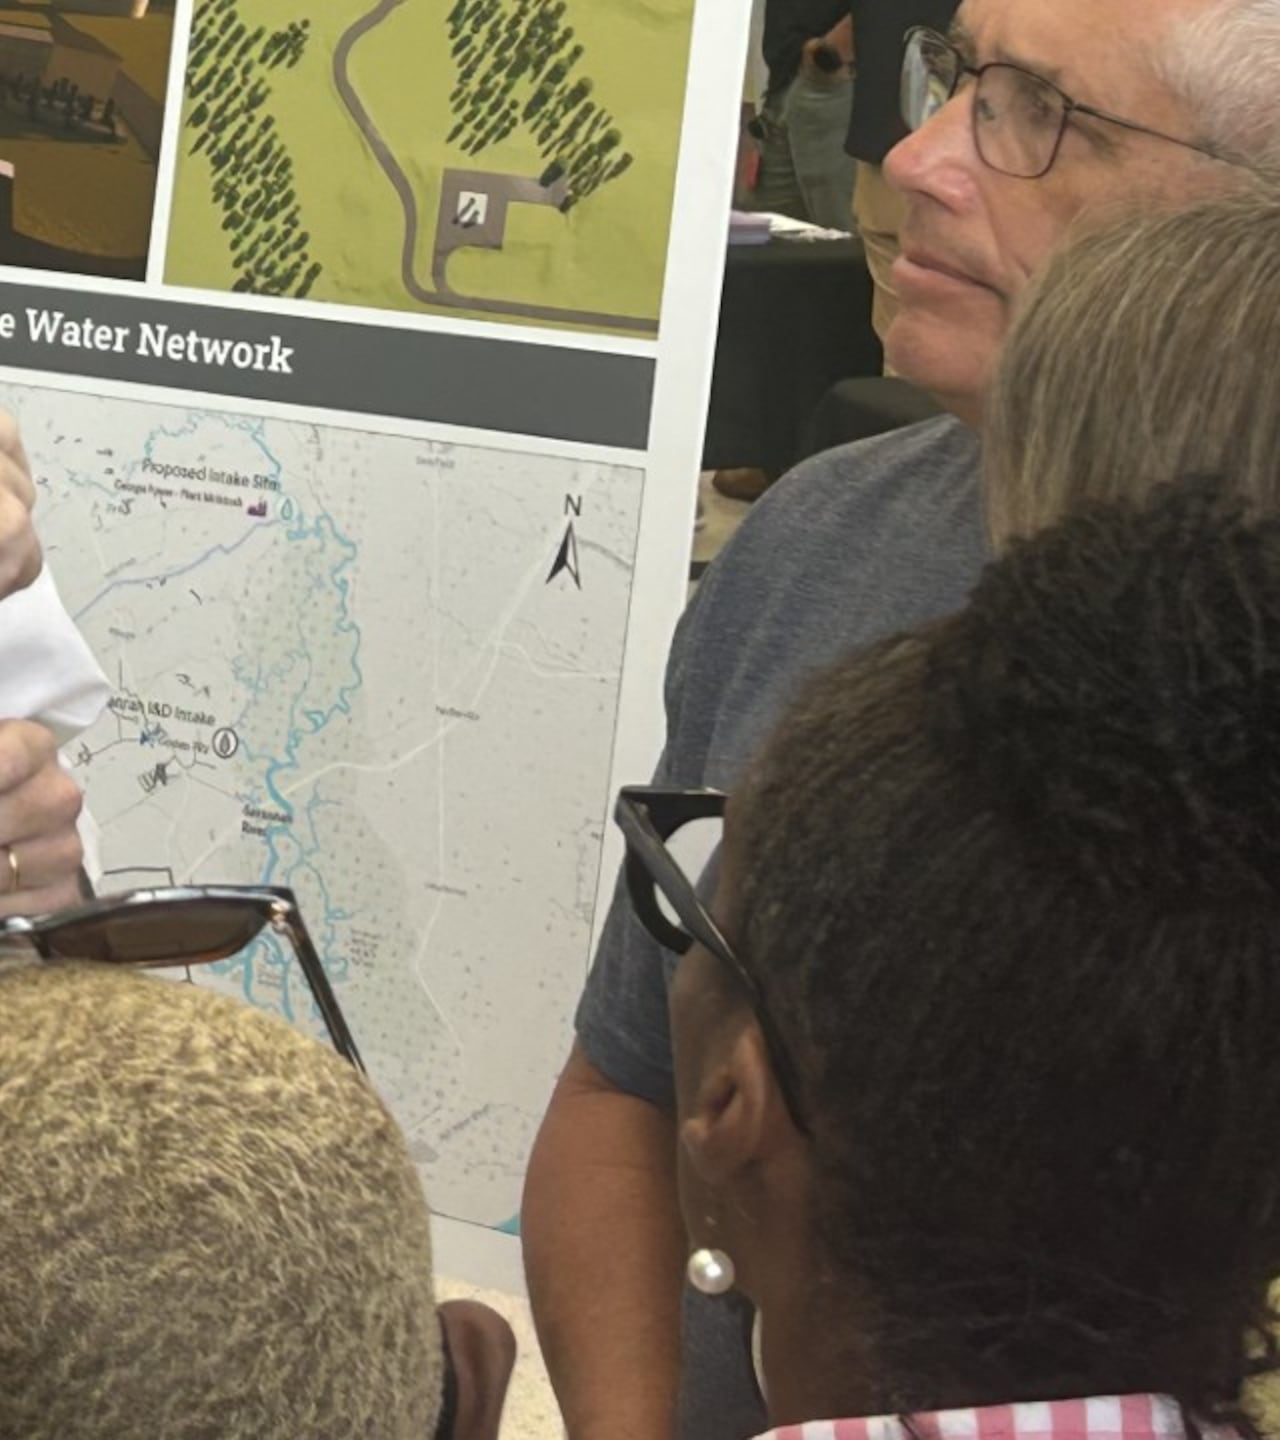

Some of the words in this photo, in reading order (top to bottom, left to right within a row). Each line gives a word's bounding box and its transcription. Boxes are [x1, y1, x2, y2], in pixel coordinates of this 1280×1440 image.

[25, 307, 130, 353] Water
[136, 321, 294, 375] Network
[141, 456, 207, 482] Proposed
[208, 465, 250, 490] Intake
[564, 492, 582, 517] N
